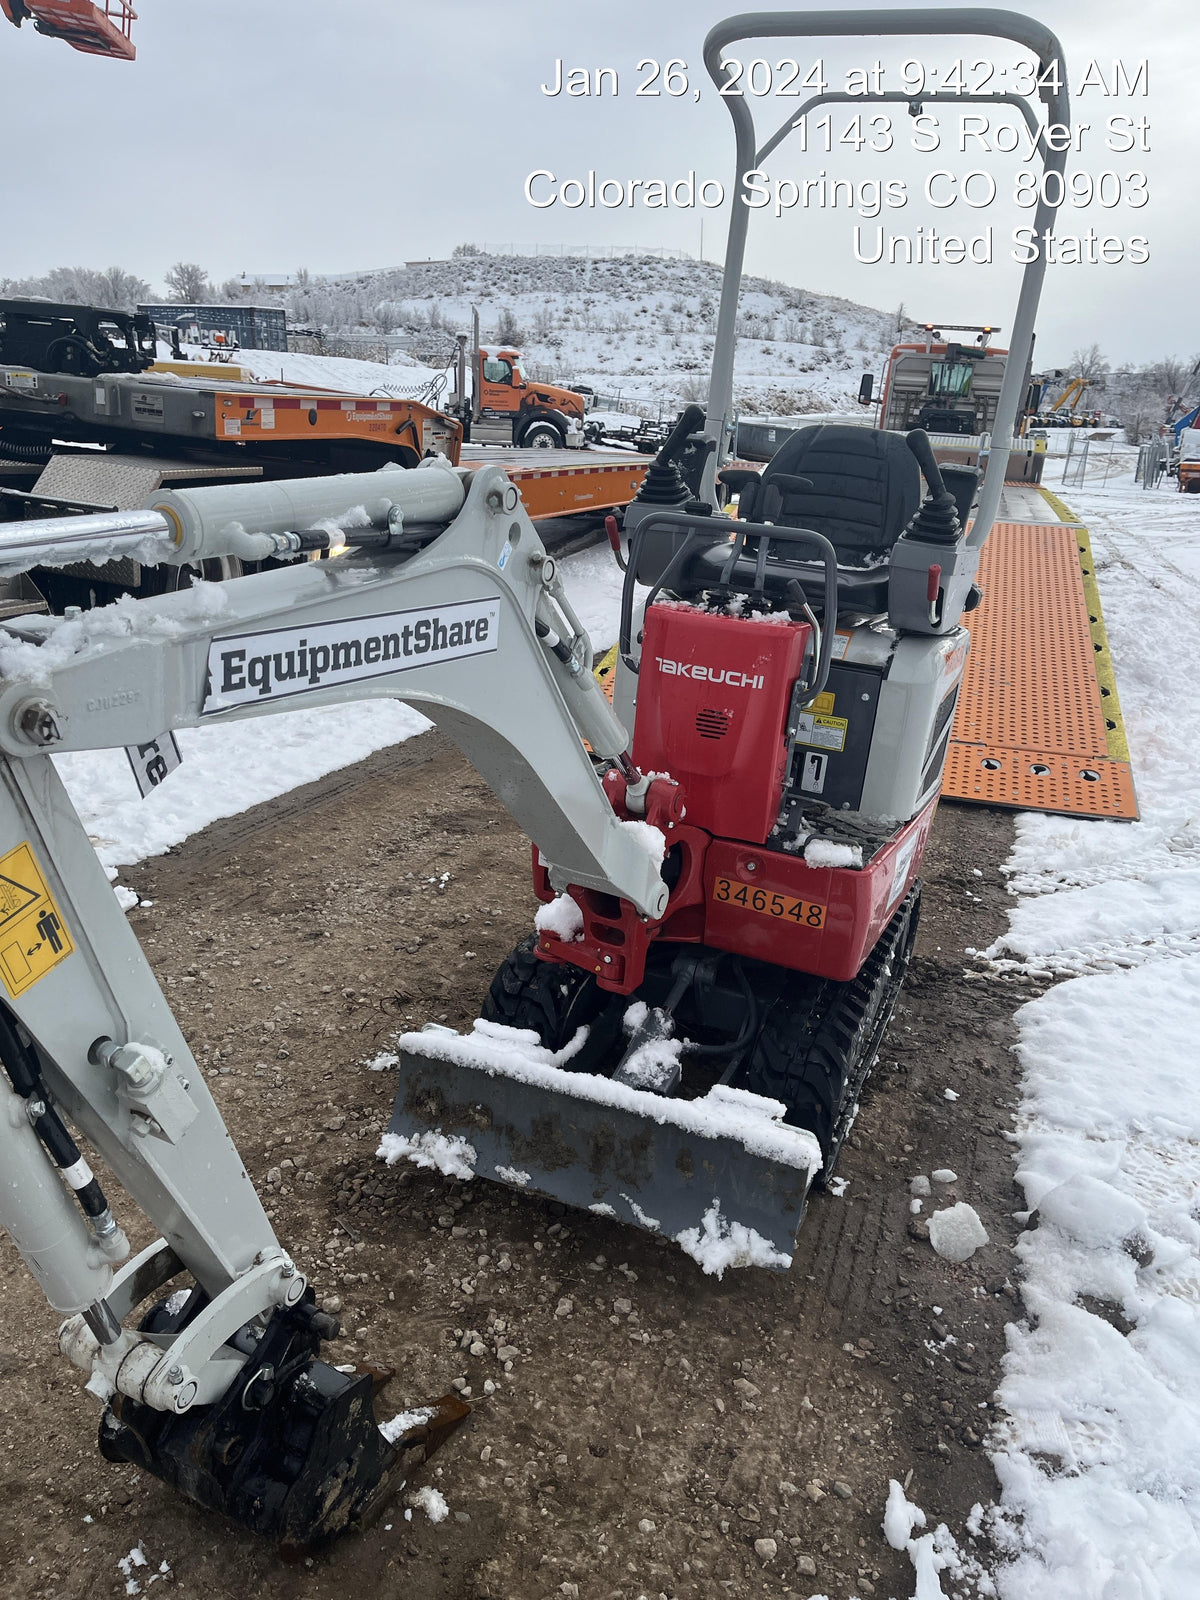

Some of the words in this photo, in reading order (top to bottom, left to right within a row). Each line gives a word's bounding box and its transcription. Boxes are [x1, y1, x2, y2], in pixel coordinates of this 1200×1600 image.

[220, 617, 489, 695] EquipmentShare
[822, 718, 845, 727] CAUTION
[716, 879, 824, 928] 346548
